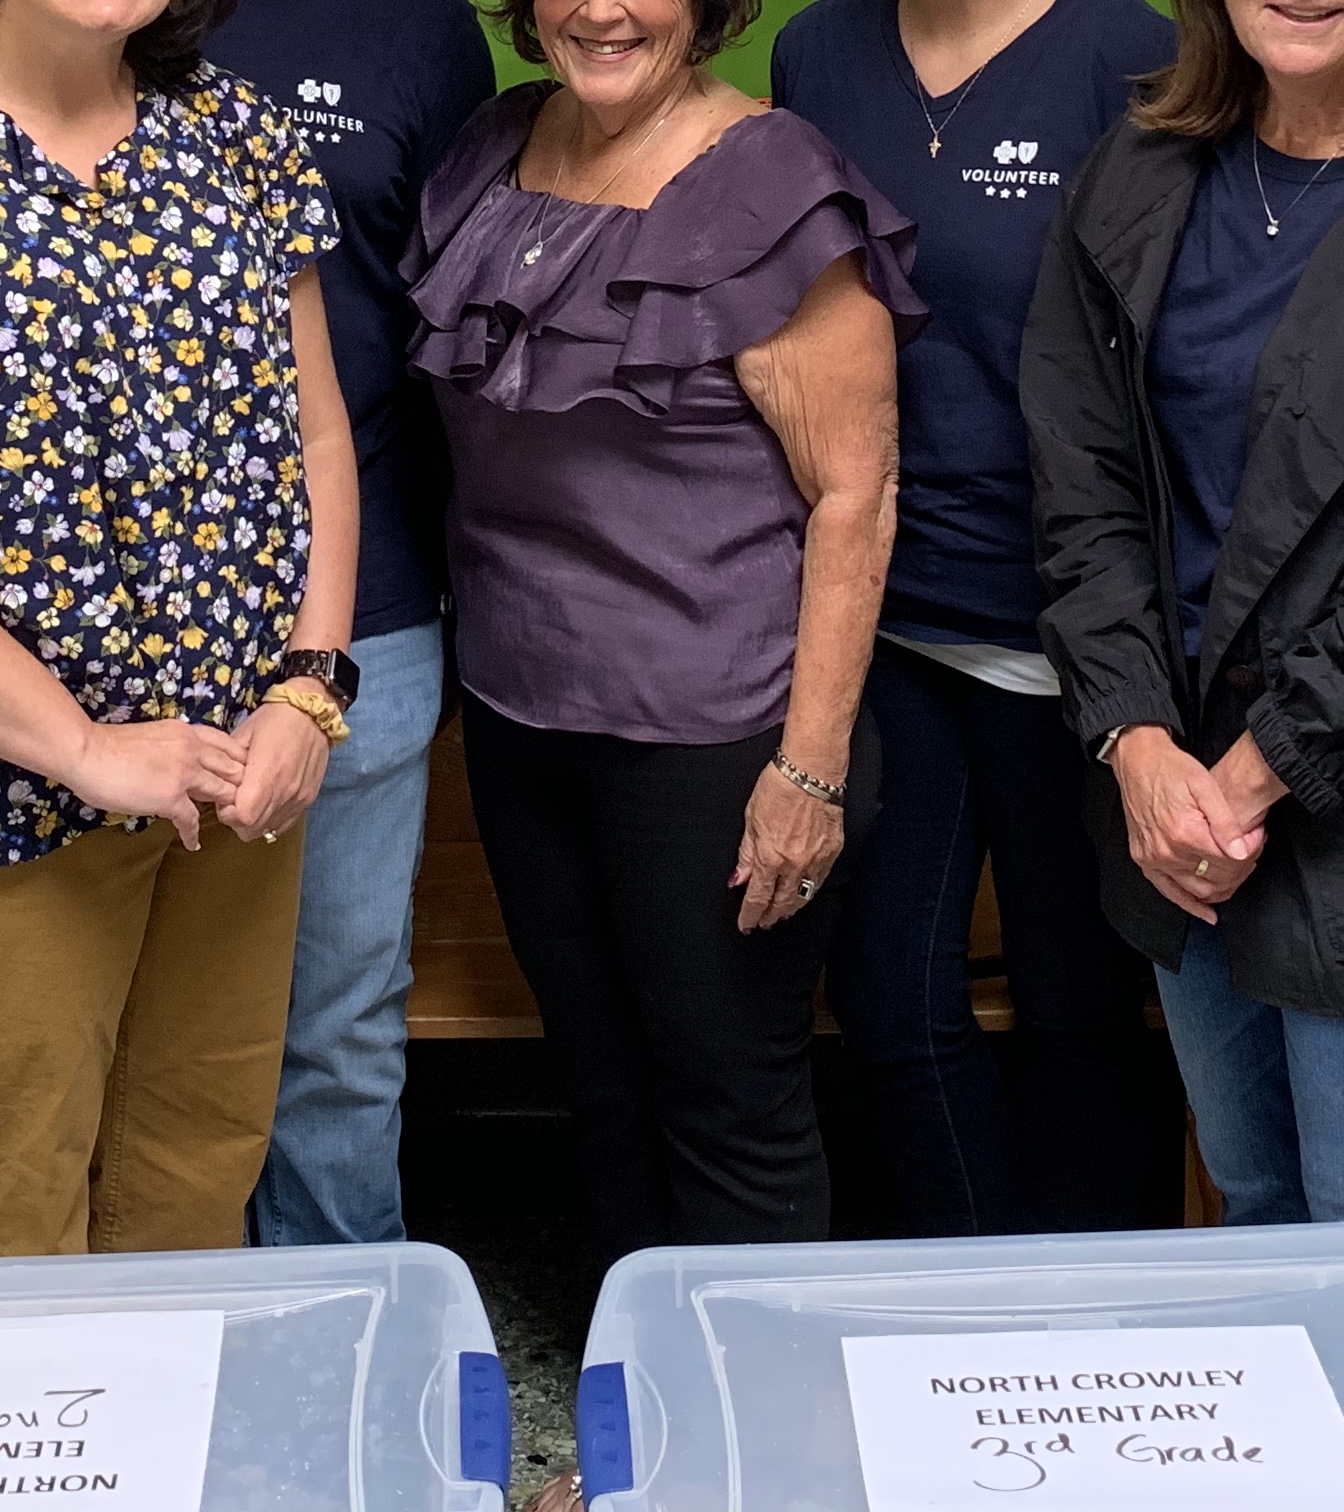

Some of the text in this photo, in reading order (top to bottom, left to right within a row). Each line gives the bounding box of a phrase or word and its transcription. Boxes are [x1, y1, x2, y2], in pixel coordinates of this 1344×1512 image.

[962, 168, 1060, 186] VOLUNTEER
[931, 1368, 1246, 1395] NORTH CROWLEY
[977, 1401, 1220, 1427] ELEMENTARY
[970, 1432, 1265, 1492] 3rd Grade
